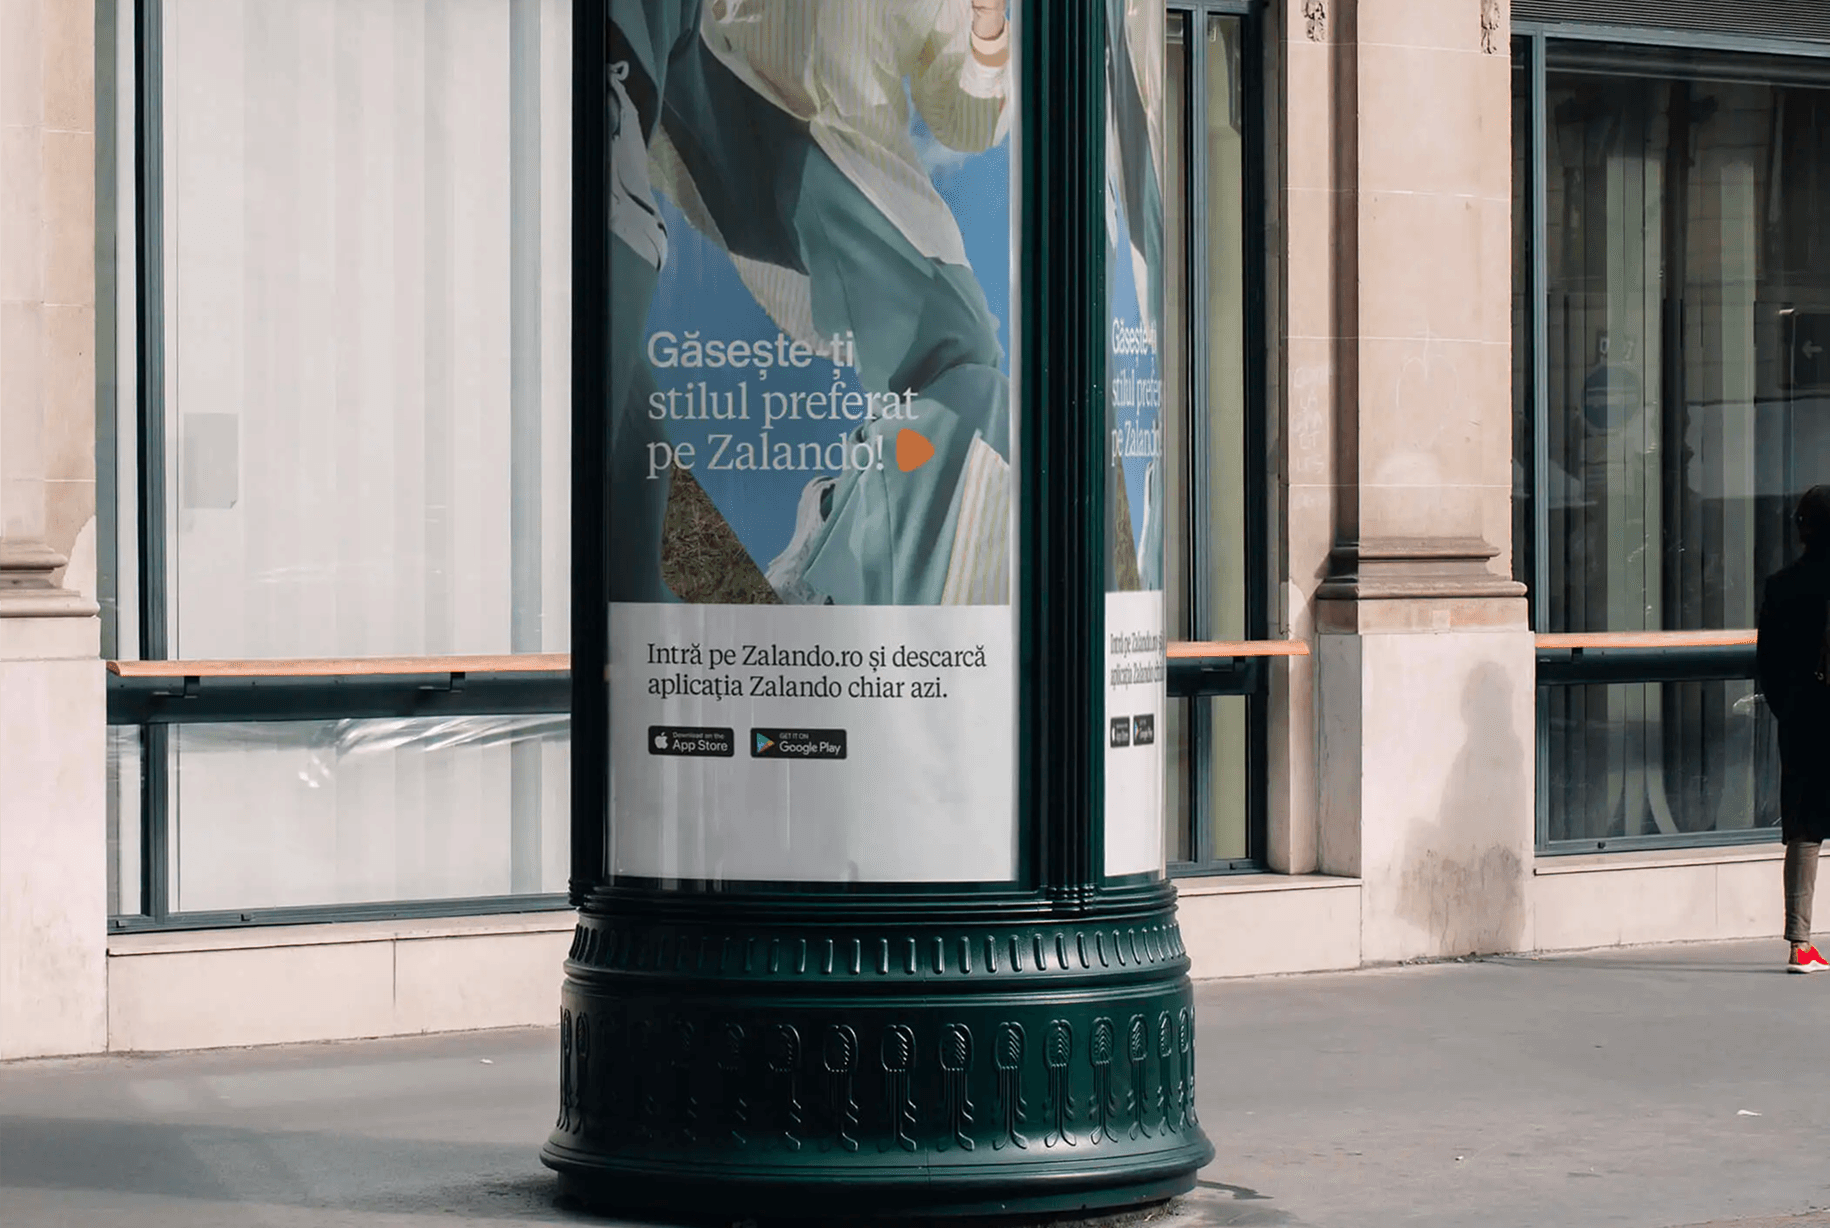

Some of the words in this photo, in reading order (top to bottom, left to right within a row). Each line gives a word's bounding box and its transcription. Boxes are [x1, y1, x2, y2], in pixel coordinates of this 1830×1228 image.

[648, 381, 750, 420] stilul
[761, 381, 919, 429] preferat
[646, 440, 695, 479] pe
[707, 432, 884, 471] Zalando!
[647, 643, 703, 665] Intră
[708, 648, 736, 670] pe
[742, 644, 863, 667] Zalando.ro
[892, 645, 987, 668] descarcă
[750, 675, 842, 698] Zalando
[848, 676, 905, 698] chiar
[911, 677, 948, 698] azi.
[672, 739, 696, 752] App
[697, 739, 728, 751] Store
[779, 740, 818, 755] Google
[819, 741, 841, 755] Play
